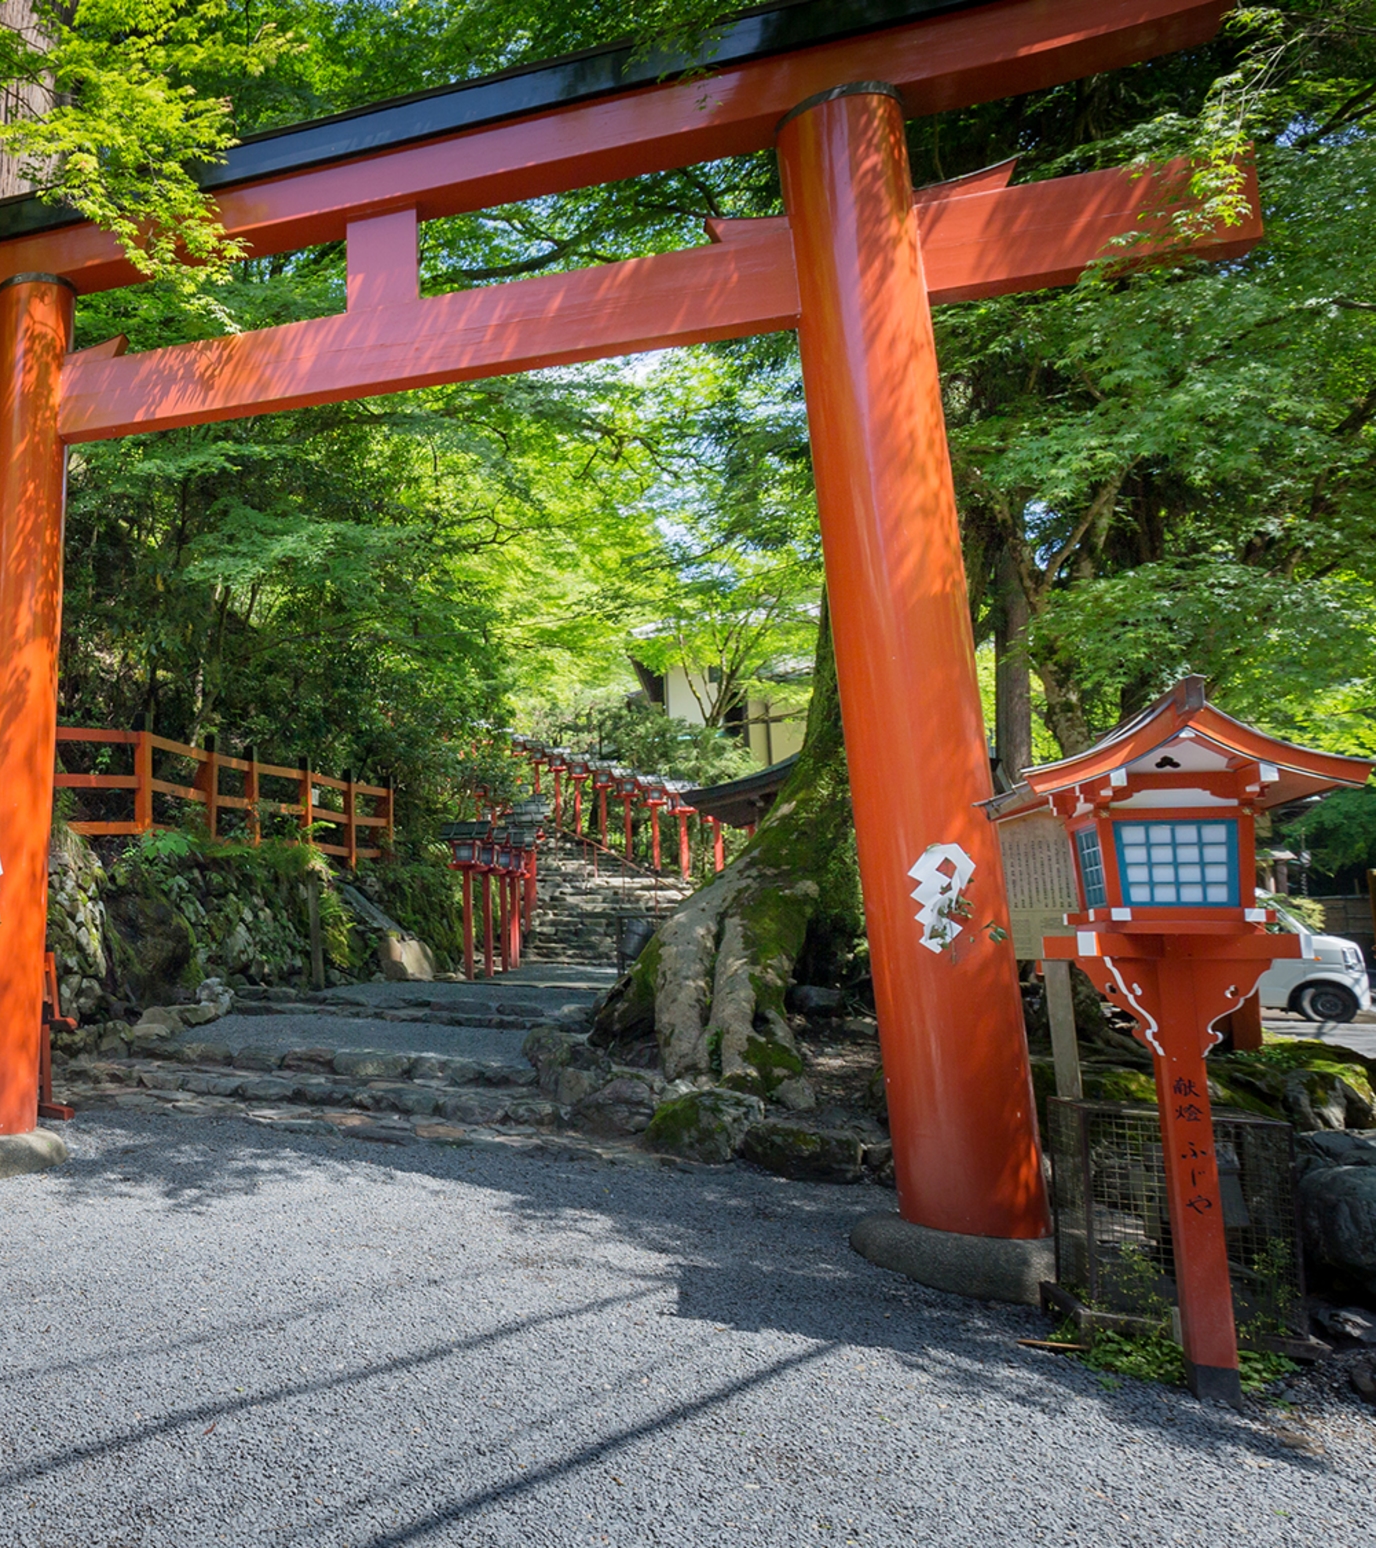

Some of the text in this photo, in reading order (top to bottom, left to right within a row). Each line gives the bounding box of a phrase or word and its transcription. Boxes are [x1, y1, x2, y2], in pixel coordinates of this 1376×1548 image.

[1173, 1077, 1213, 1215] 献燈 ふじや
